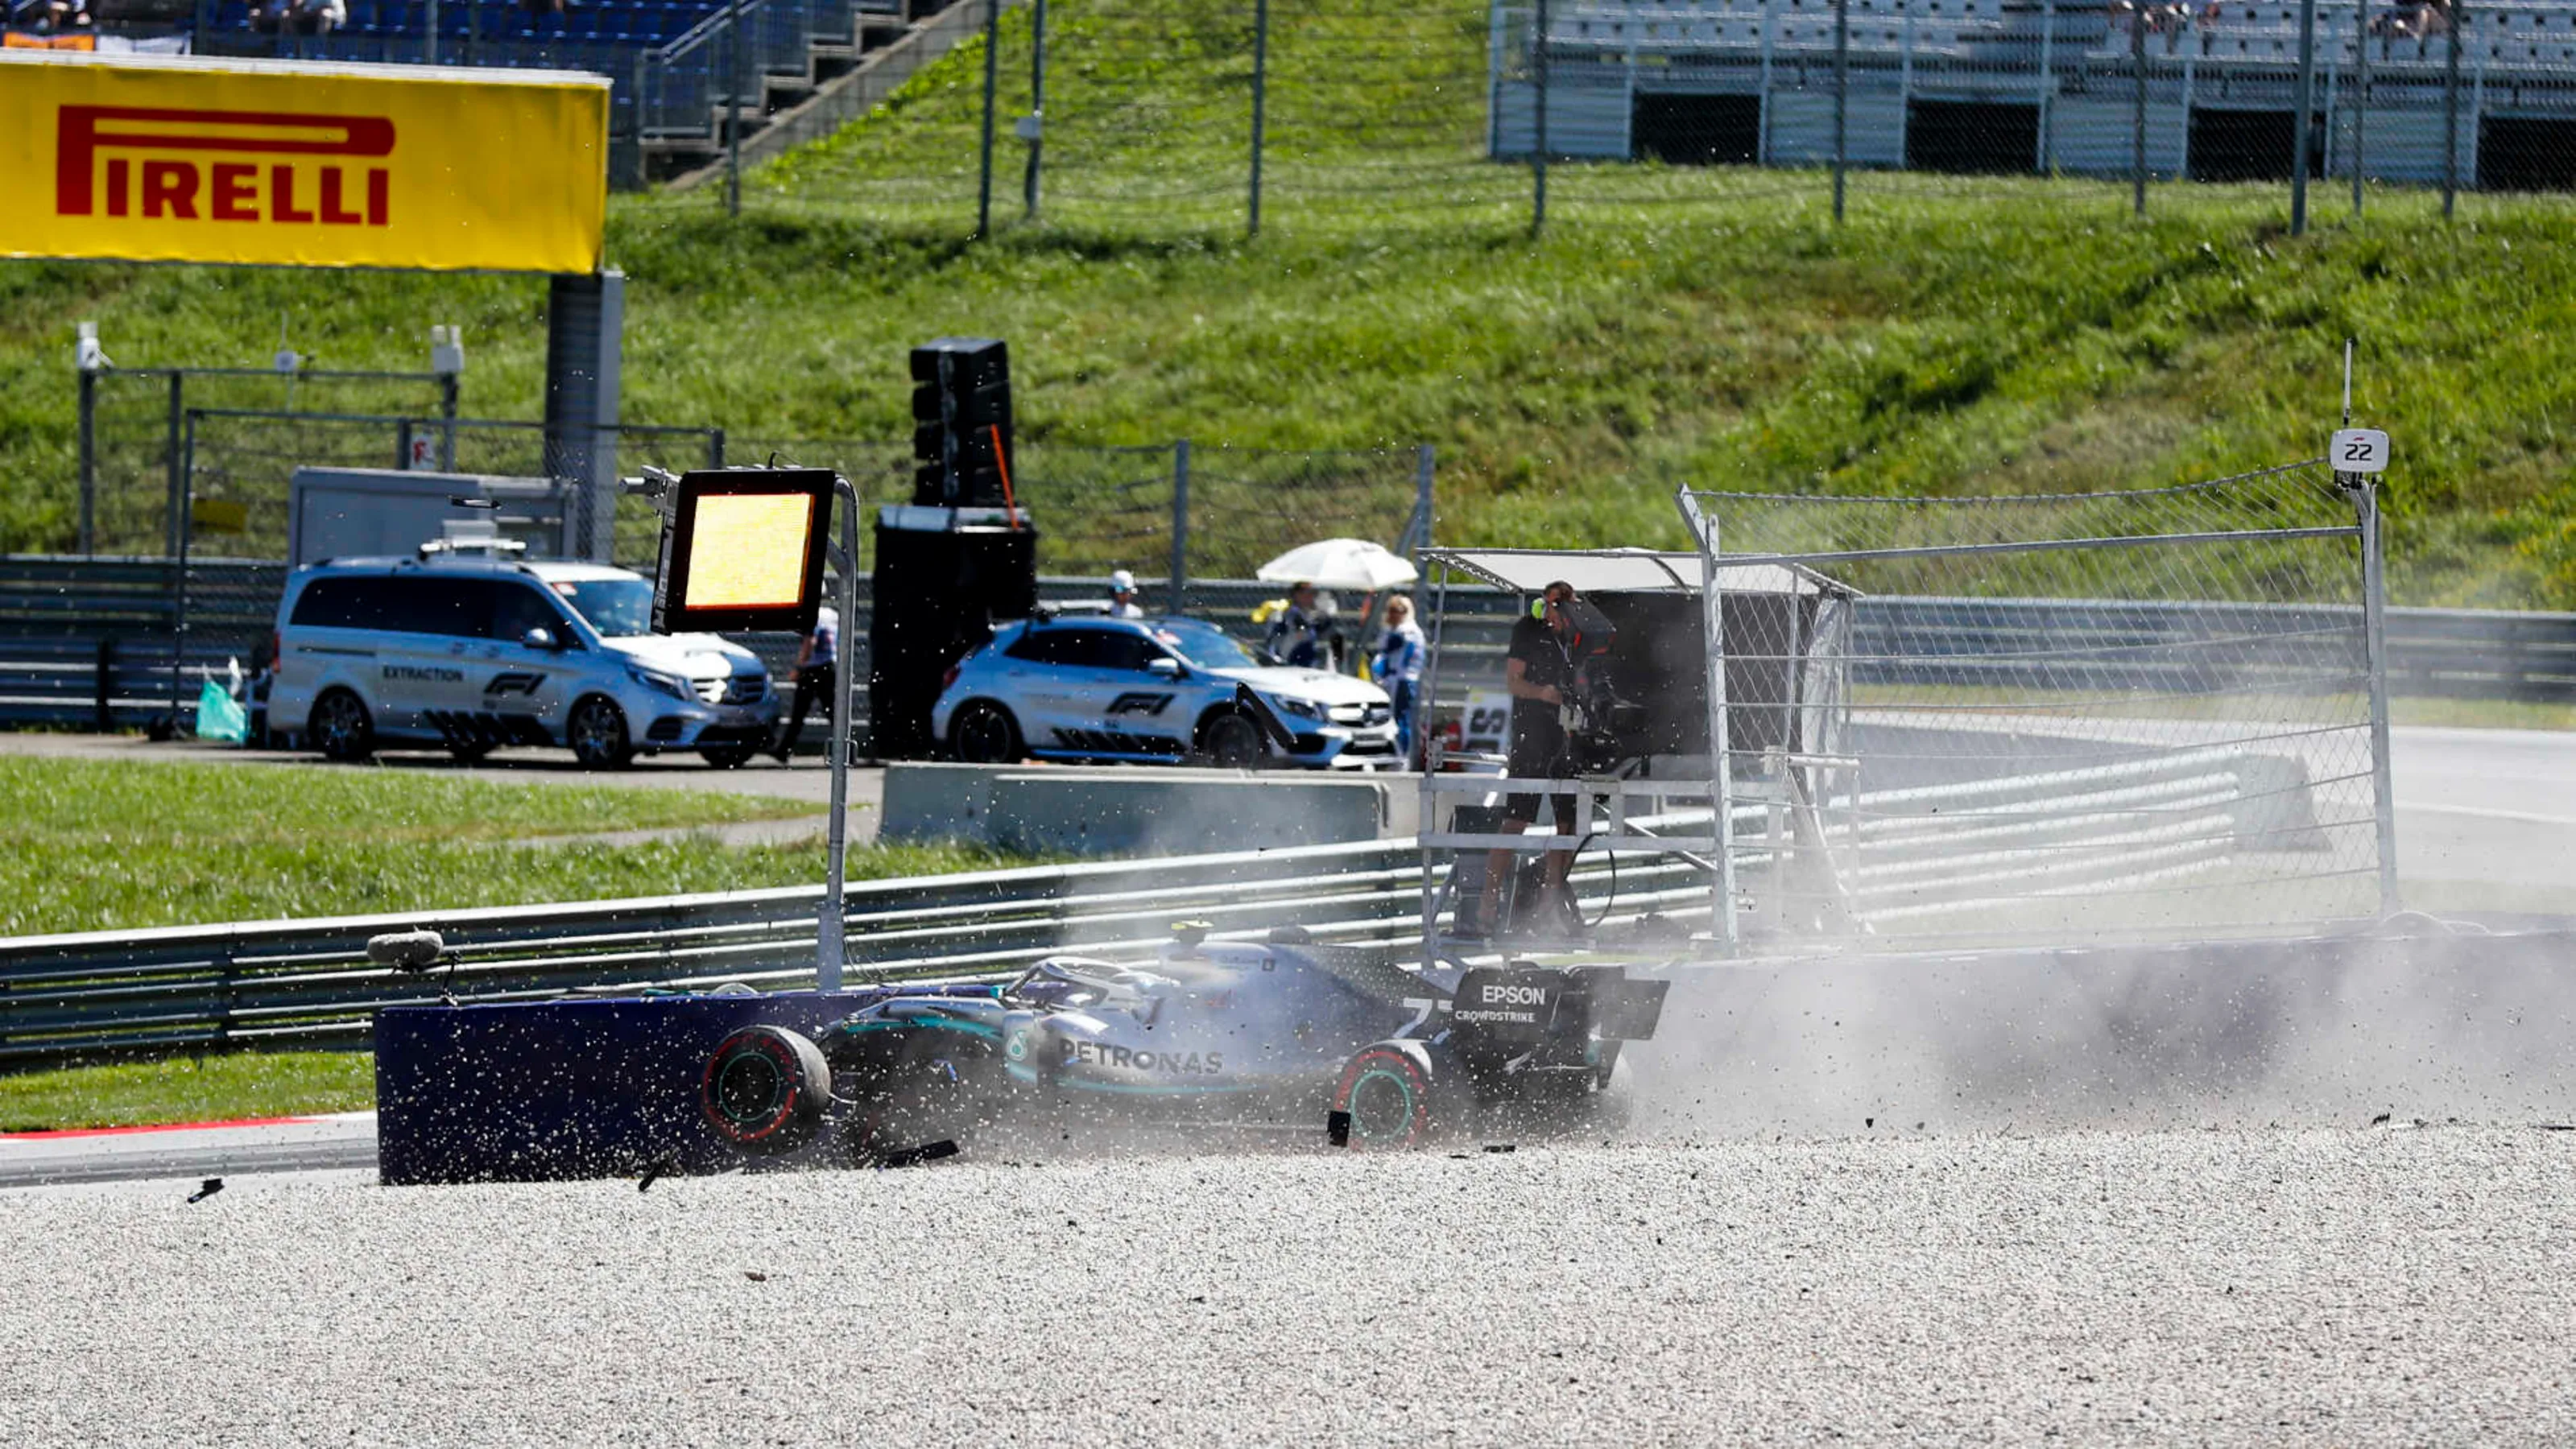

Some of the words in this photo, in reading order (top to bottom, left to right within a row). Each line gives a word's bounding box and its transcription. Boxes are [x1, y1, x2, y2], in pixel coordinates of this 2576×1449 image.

[56, 105, 396, 226] PIRELLI
[2345, 444, 2372, 461] 22
[383, 665, 464, 682] EXTRACTION
[1482, 985, 1546, 1005] EPSON
[1454, 1009, 1536, 1023] CROWDSTRIKE
[1058, 1038, 1224, 1075] PETRONAS
